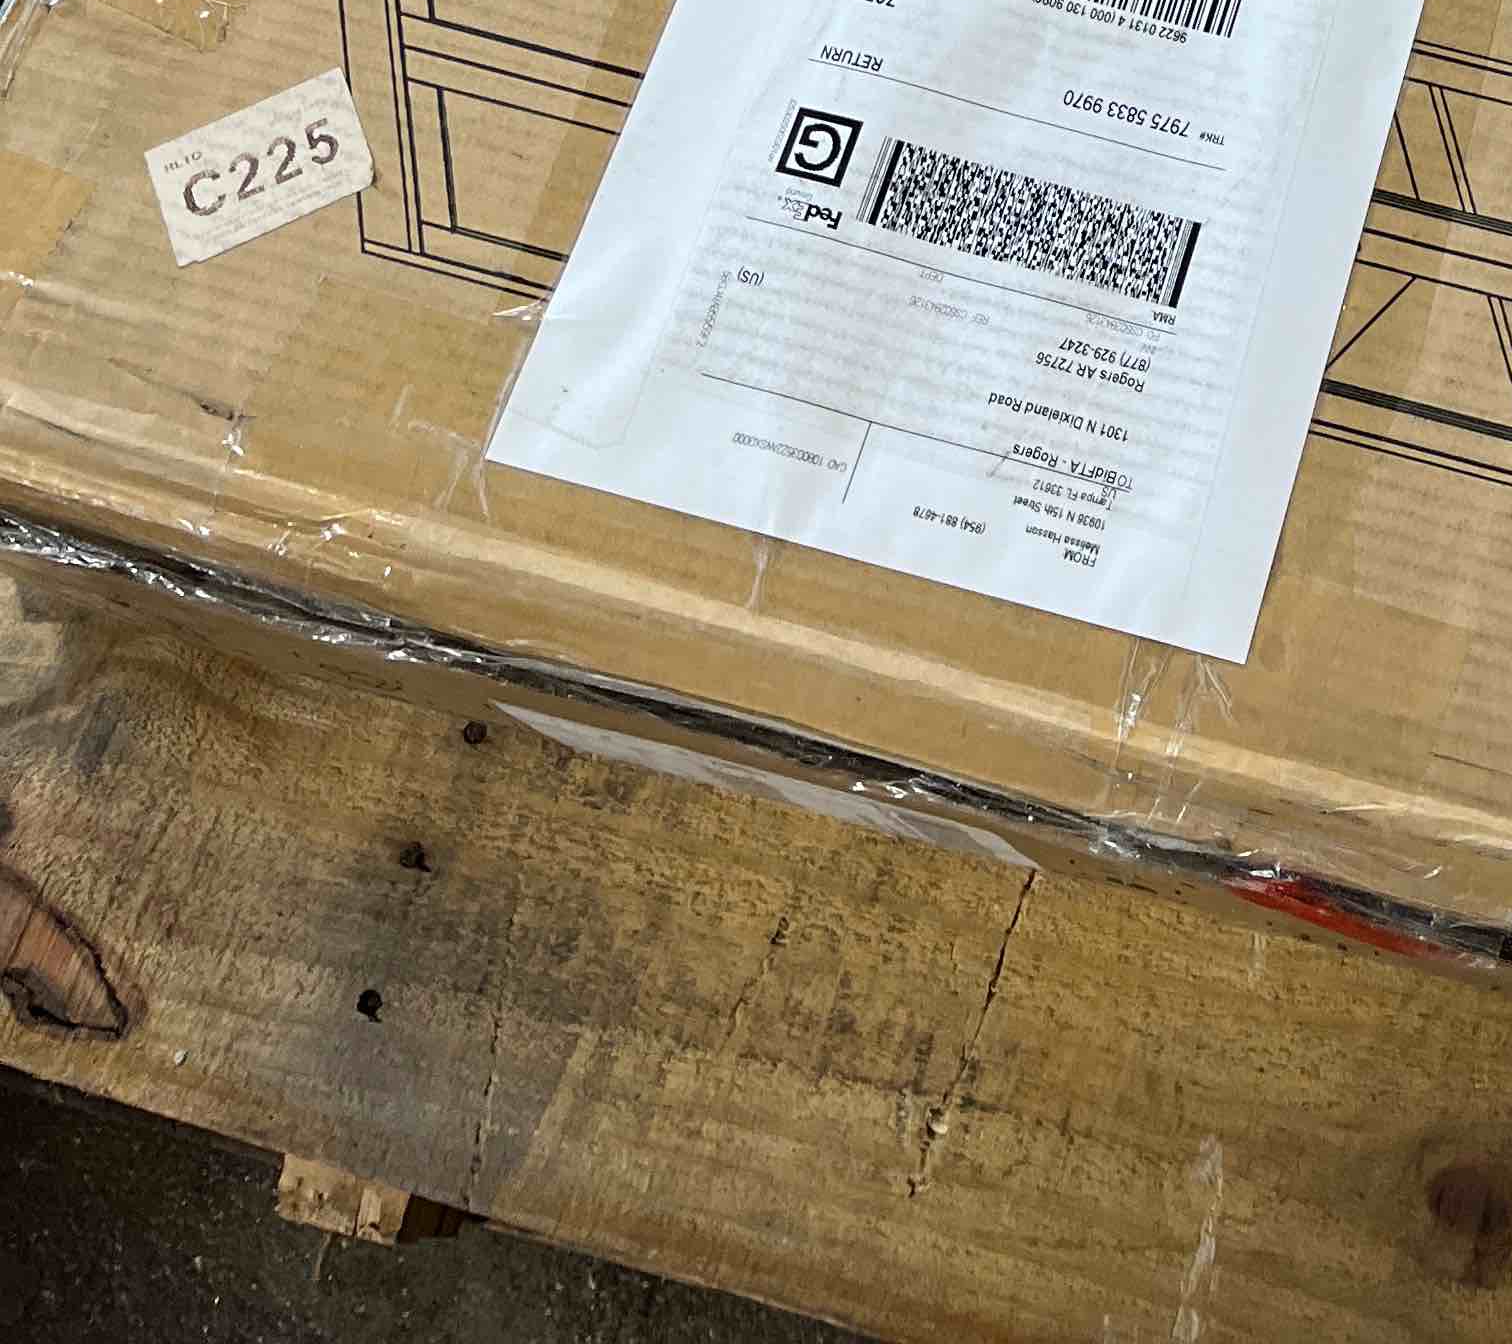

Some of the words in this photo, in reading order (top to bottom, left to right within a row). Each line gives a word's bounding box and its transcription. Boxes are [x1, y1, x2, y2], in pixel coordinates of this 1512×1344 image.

[1066, 0, 1087, 15] 130
[1090, 6, 1116, 24] (000
[1117, 16, 1126, 29] 4
[1129, 21, 1156, 37] 0131
[1158, 28, 1187, 44] 9622
[820, 44, 884, 72] RETURN
[1063, 89, 1102, 114] 9970
[1107, 102, 1147, 126] 5833
[1150, 113, 1190, 138] 7975
[794, 123, 841, 171] G
[1199, 130, 1225, 146] TRK#
[183, 118, 339, 216] C225
[781, 196, 843, 230] FedEx
[737, 266, 765, 288] (US)
[1058, 336, 1117, 364] 929-3247
[1034, 350, 1074, 373] 72756
[1075, 362, 1097, 379] AR
[1118, 350, 1152, 373] (877)
[1098, 365, 1145, 393] Rogers
[987, 391, 1022, 412] Road
[1023, 401, 1084, 430] Dixieland
[1085, 419, 1097, 433] N
[1099, 422, 1130, 442] 1301
[1011, 439, 1059, 467] Rogers
[1067, 458, 1117, 484] BidFTA
[1031, 477, 1063, 496] 33612
[1064, 487, 1078, 500] FL
[1012, 495, 1042, 512] Street
[1078, 487, 1114, 510] Tampa
[1042, 503, 1064, 518] 15th
[1065, 510, 1075, 522] N
[958, 515, 987, 535] (954)
